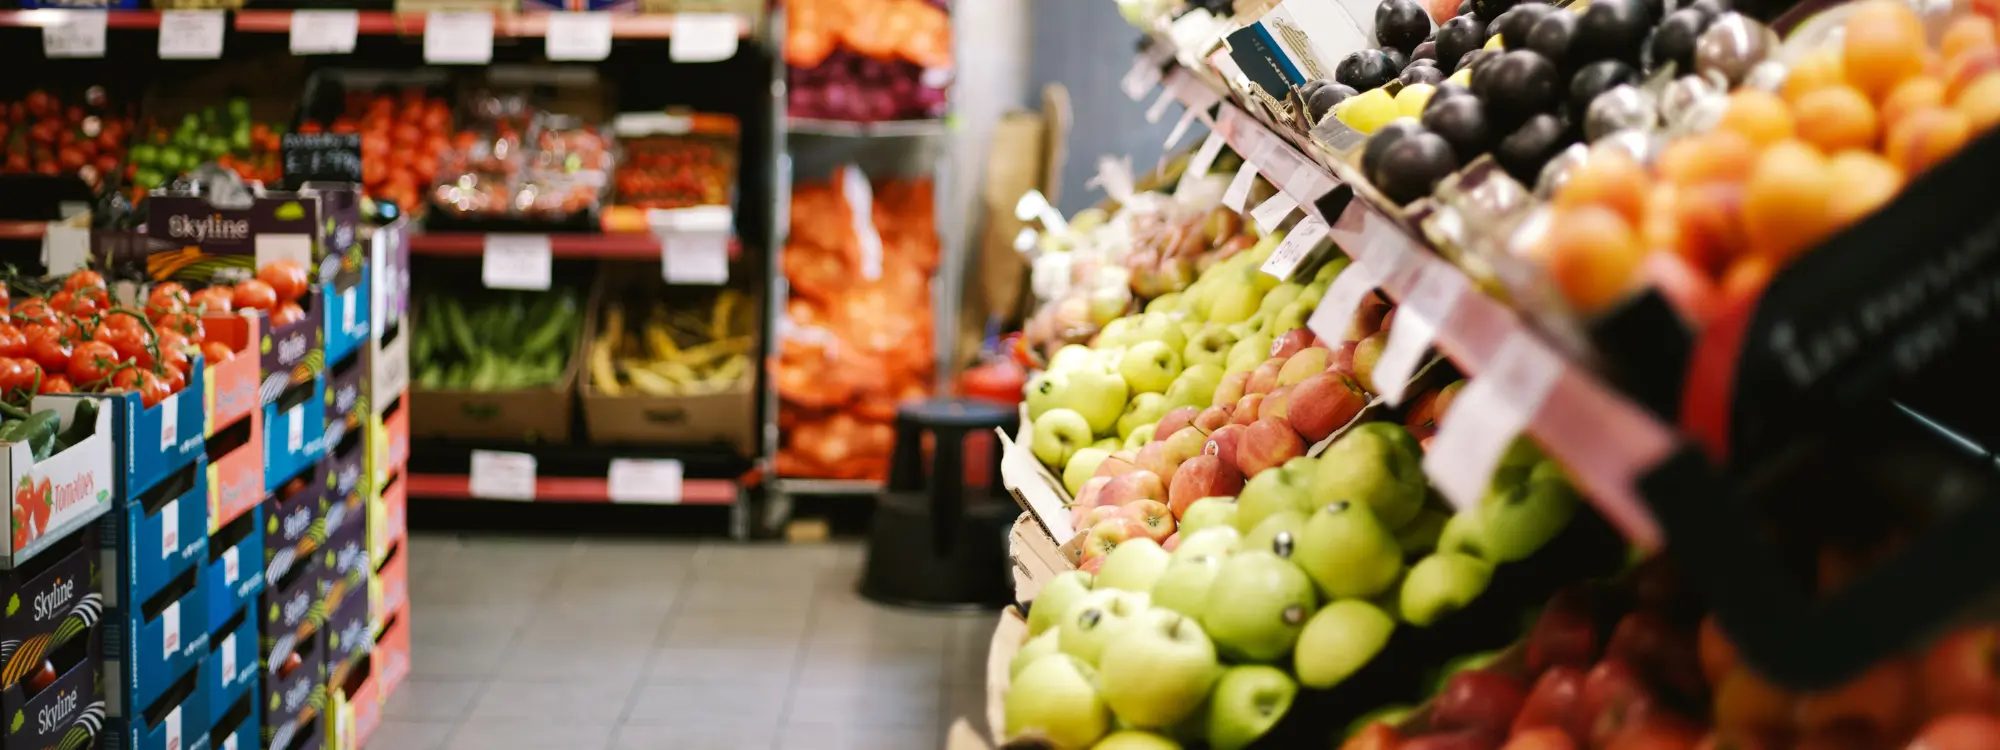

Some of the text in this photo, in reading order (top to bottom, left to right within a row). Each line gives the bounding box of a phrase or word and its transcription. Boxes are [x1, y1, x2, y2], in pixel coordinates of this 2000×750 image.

[168, 212, 249, 242] Skyline
[55, 470, 94, 513] Tomatoes
[34, 577, 74, 621] Skyline
[38, 689, 77, 735] Skyline
